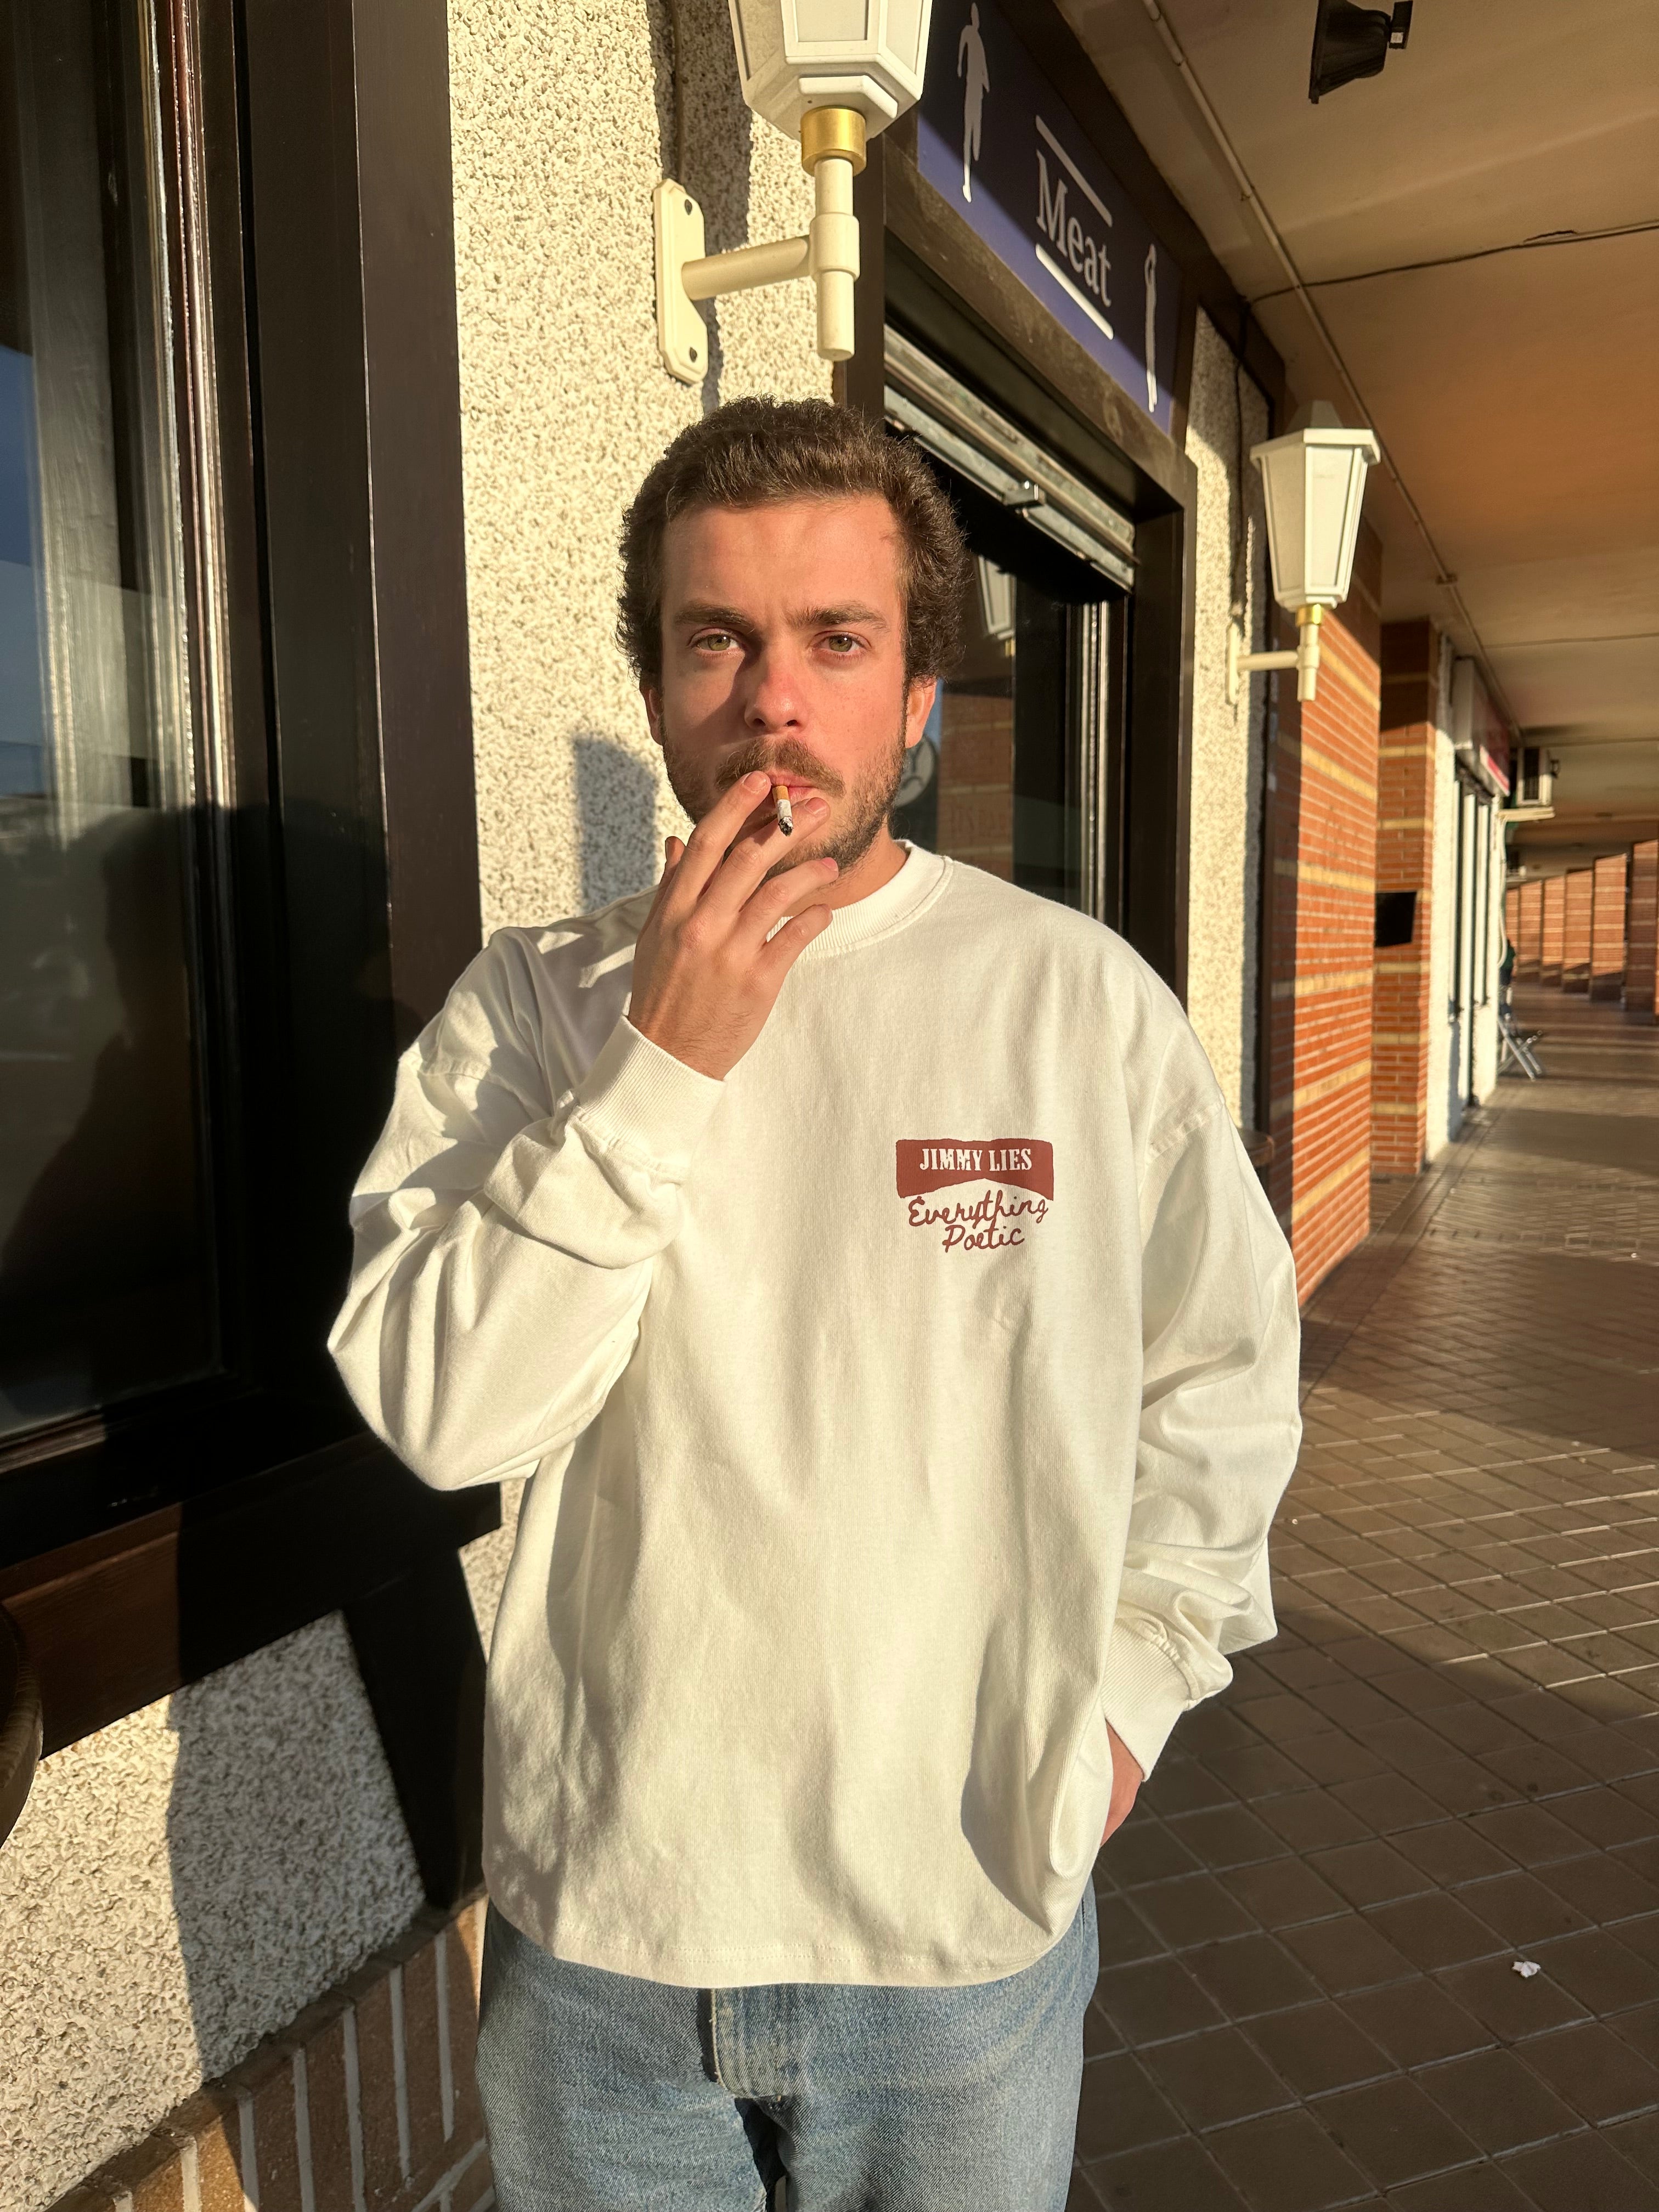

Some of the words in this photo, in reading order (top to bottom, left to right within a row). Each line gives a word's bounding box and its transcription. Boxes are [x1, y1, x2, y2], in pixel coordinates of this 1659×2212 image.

[1036, 149, 1111, 307] Meat
[919, 1148, 983, 1171] JIMMY
[989, 1148, 1032, 1172] LIES
[908, 1189, 1048, 1229] Everything
[942, 1222, 1025, 1252] Poetic
